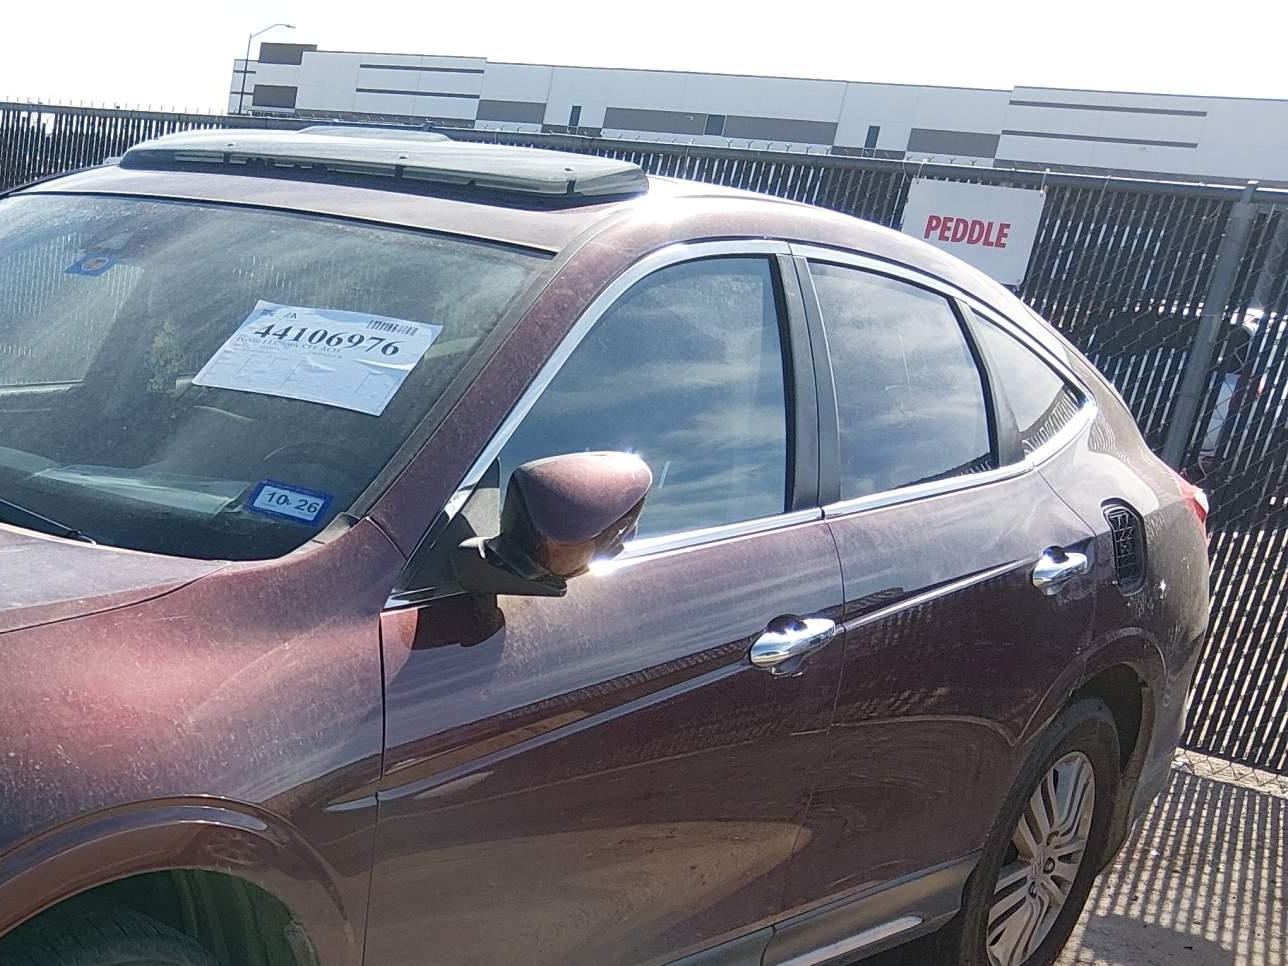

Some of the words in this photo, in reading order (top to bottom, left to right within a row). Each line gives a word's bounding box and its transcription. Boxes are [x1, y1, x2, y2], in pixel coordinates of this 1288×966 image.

[923, 215, 1011, 248] PEDDLE
[254, 323, 402, 356] 44106976
[267, 491, 288, 506] 10
[294, 499, 320, 514] 26
